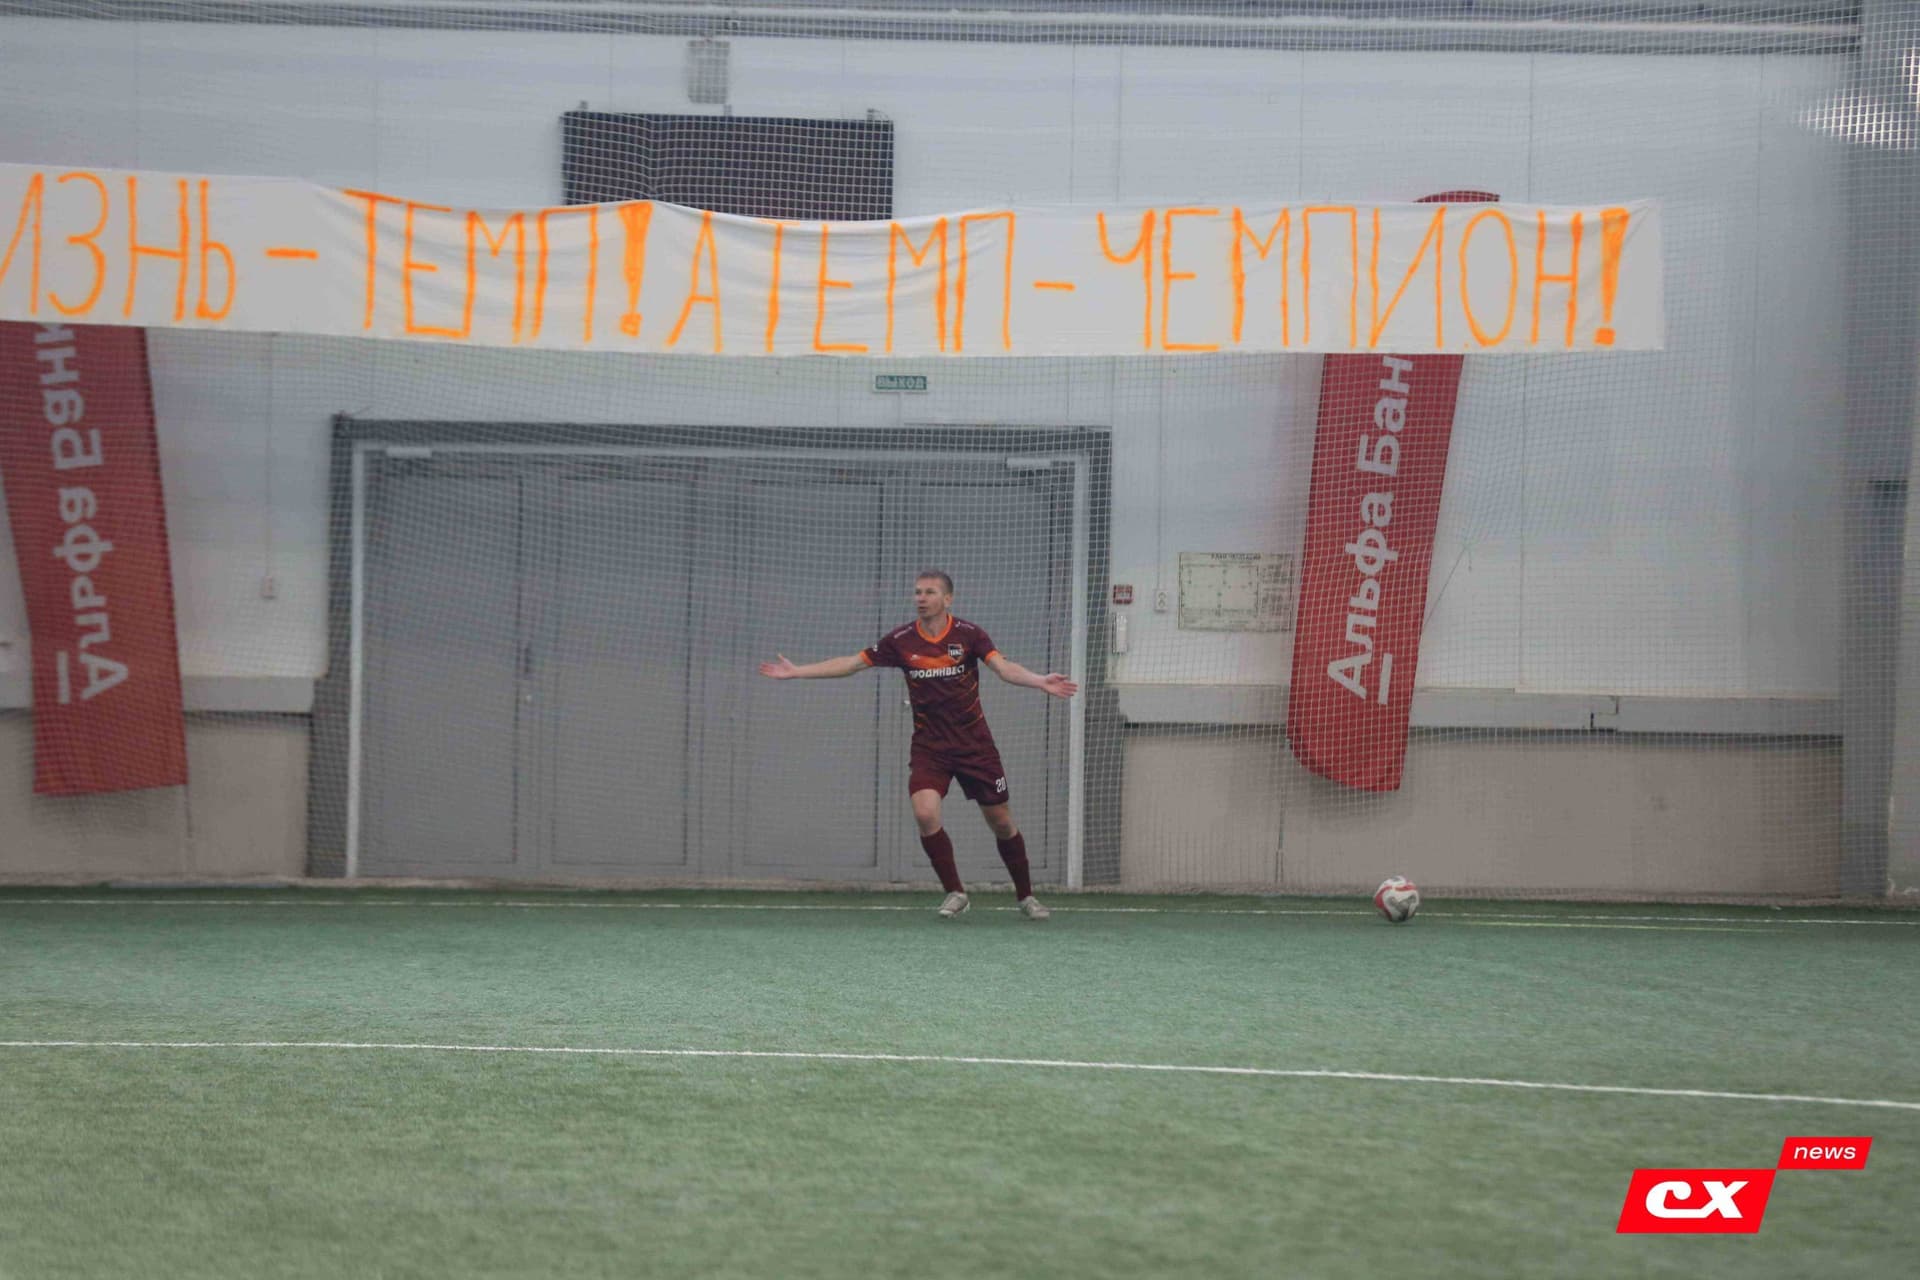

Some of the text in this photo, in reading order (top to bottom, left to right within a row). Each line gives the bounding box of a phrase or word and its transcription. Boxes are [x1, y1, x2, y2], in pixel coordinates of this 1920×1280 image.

[340, 188, 653, 344] ТЕМП!
[1097, 205, 1630, 351] ЧЕМПИОН!
[1327, 491, 1399, 700] Альфа
